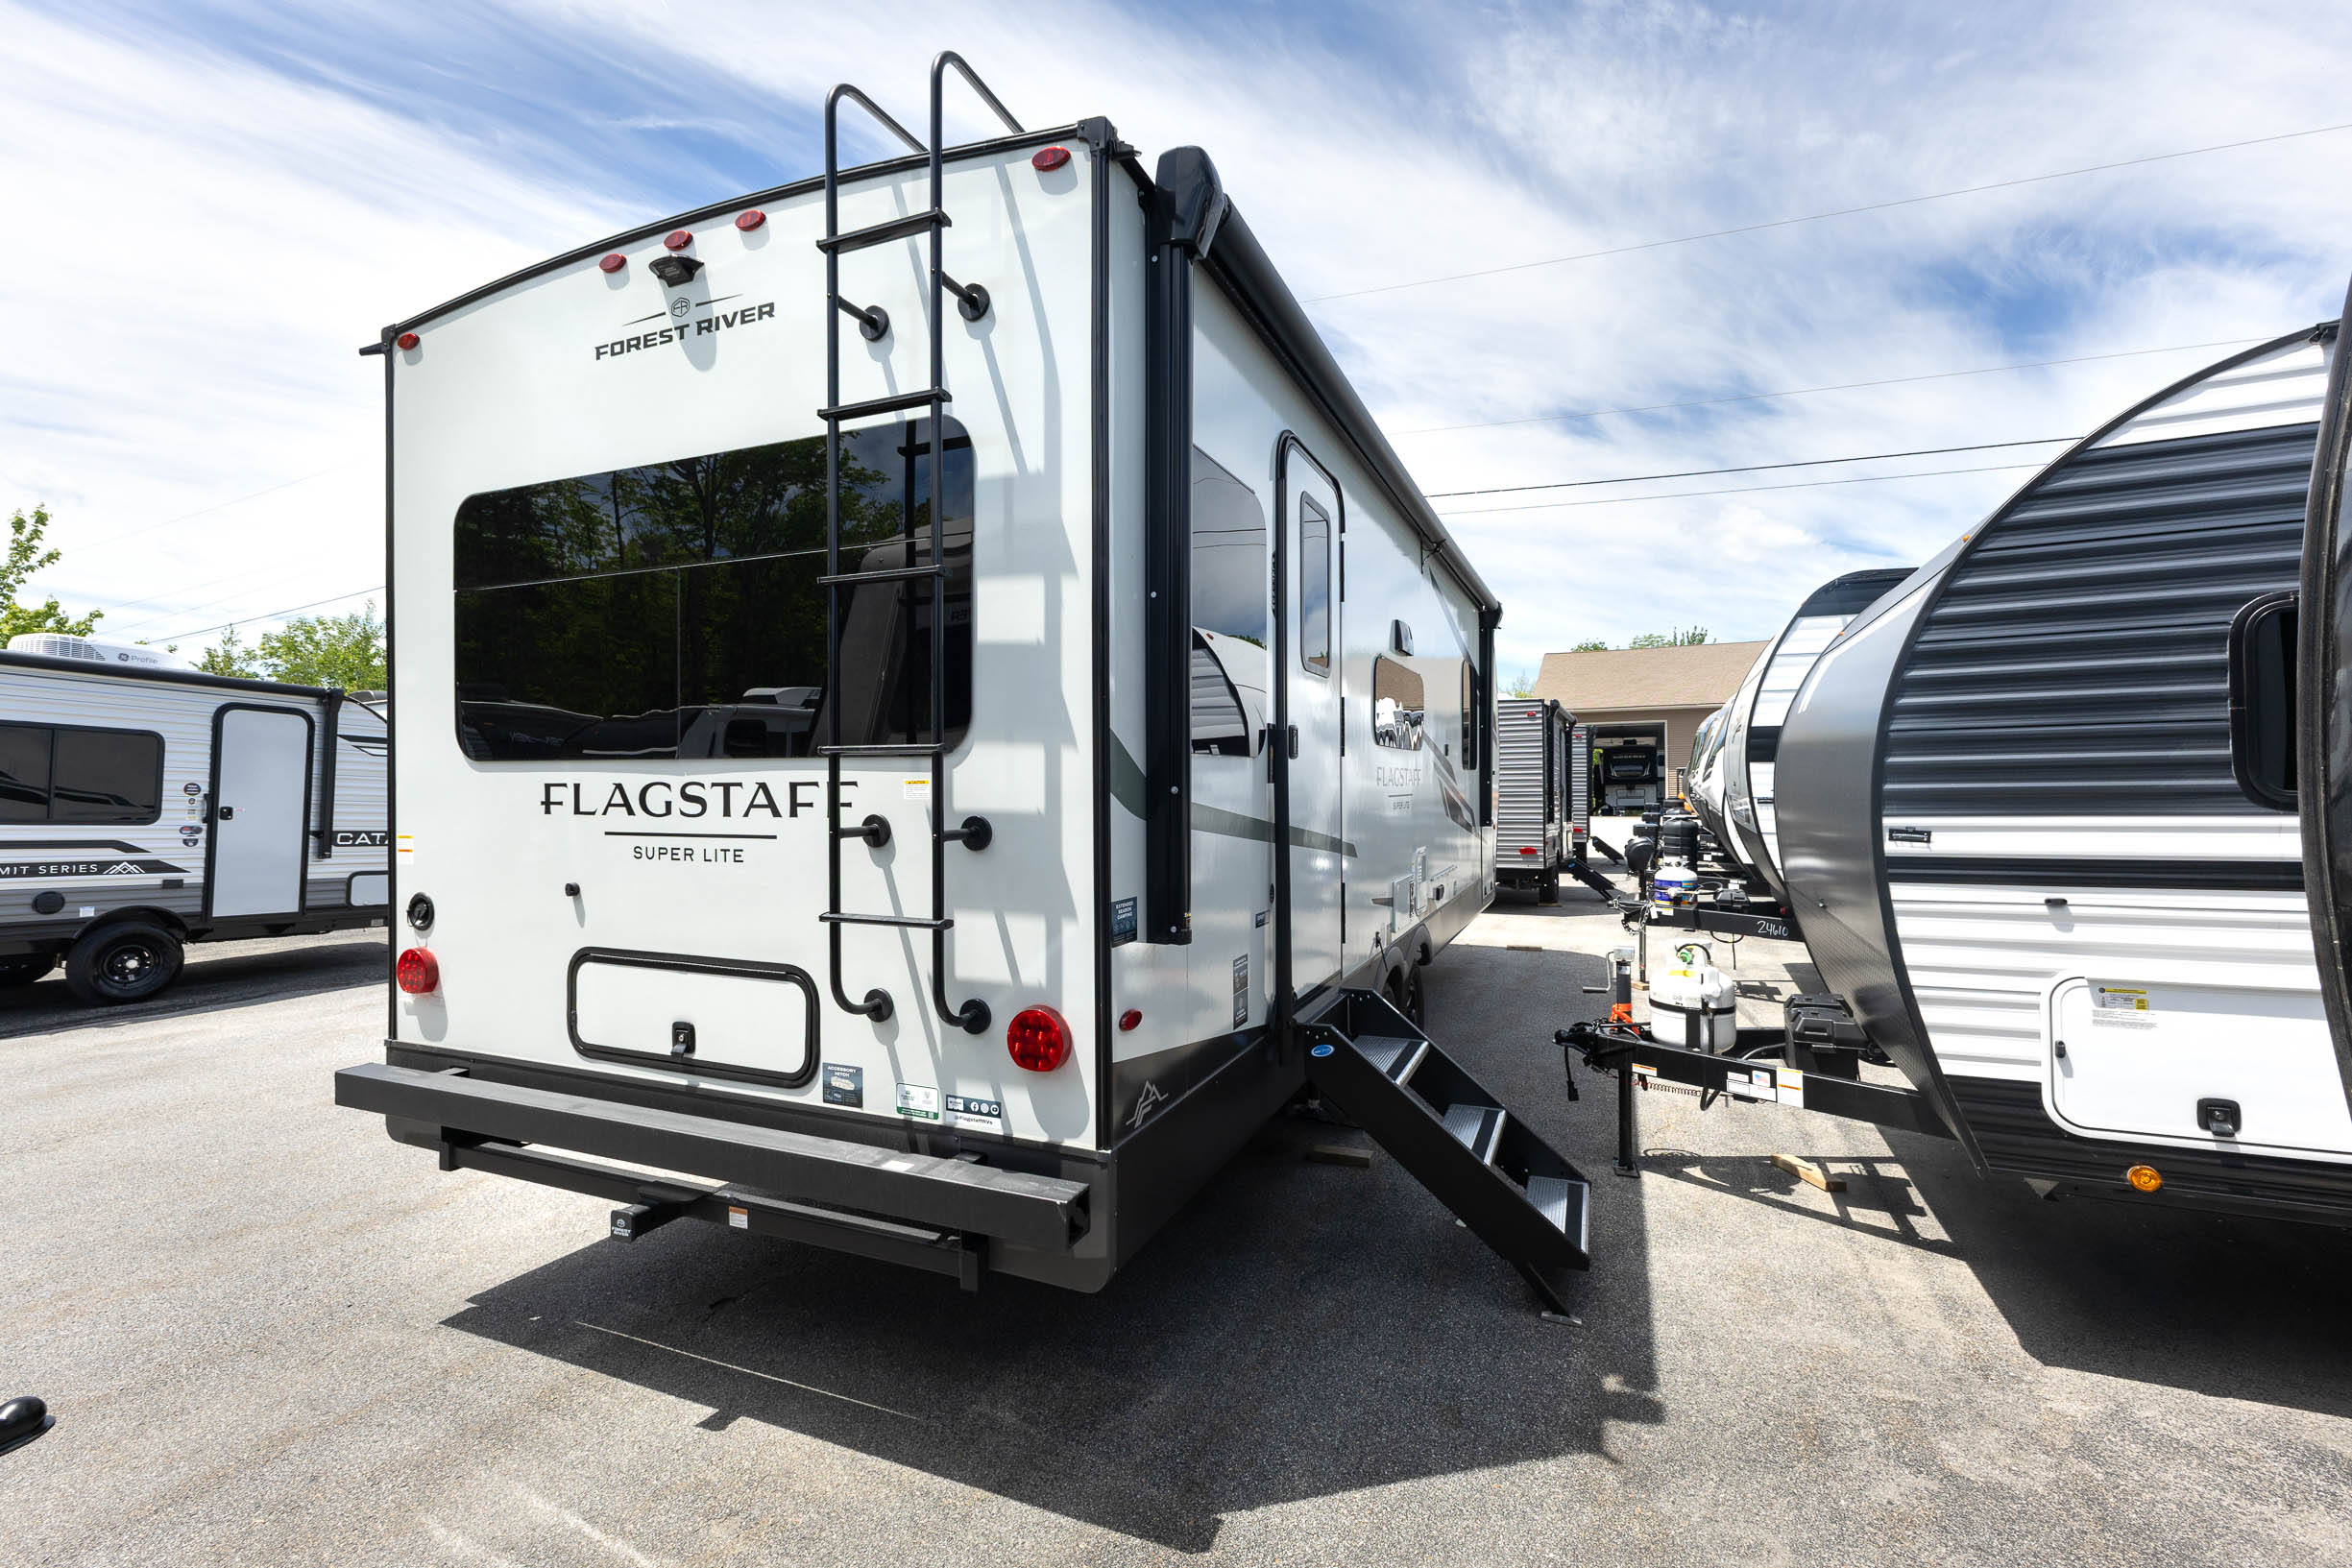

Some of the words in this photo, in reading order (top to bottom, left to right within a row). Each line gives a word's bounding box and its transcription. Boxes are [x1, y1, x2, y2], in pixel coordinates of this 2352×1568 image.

[594, 324, 691, 361] FOREST
[695, 302, 775, 336] RIVER
[1376, 766, 1421, 786] FLAGSTAFF
[336, 832, 388, 845] CAT
[633, 845, 694, 862] SUPER
[704, 848, 744, 863] LITE
[38, 864, 98, 875] SERIES
[1757, 920, 1789, 937] 24610
